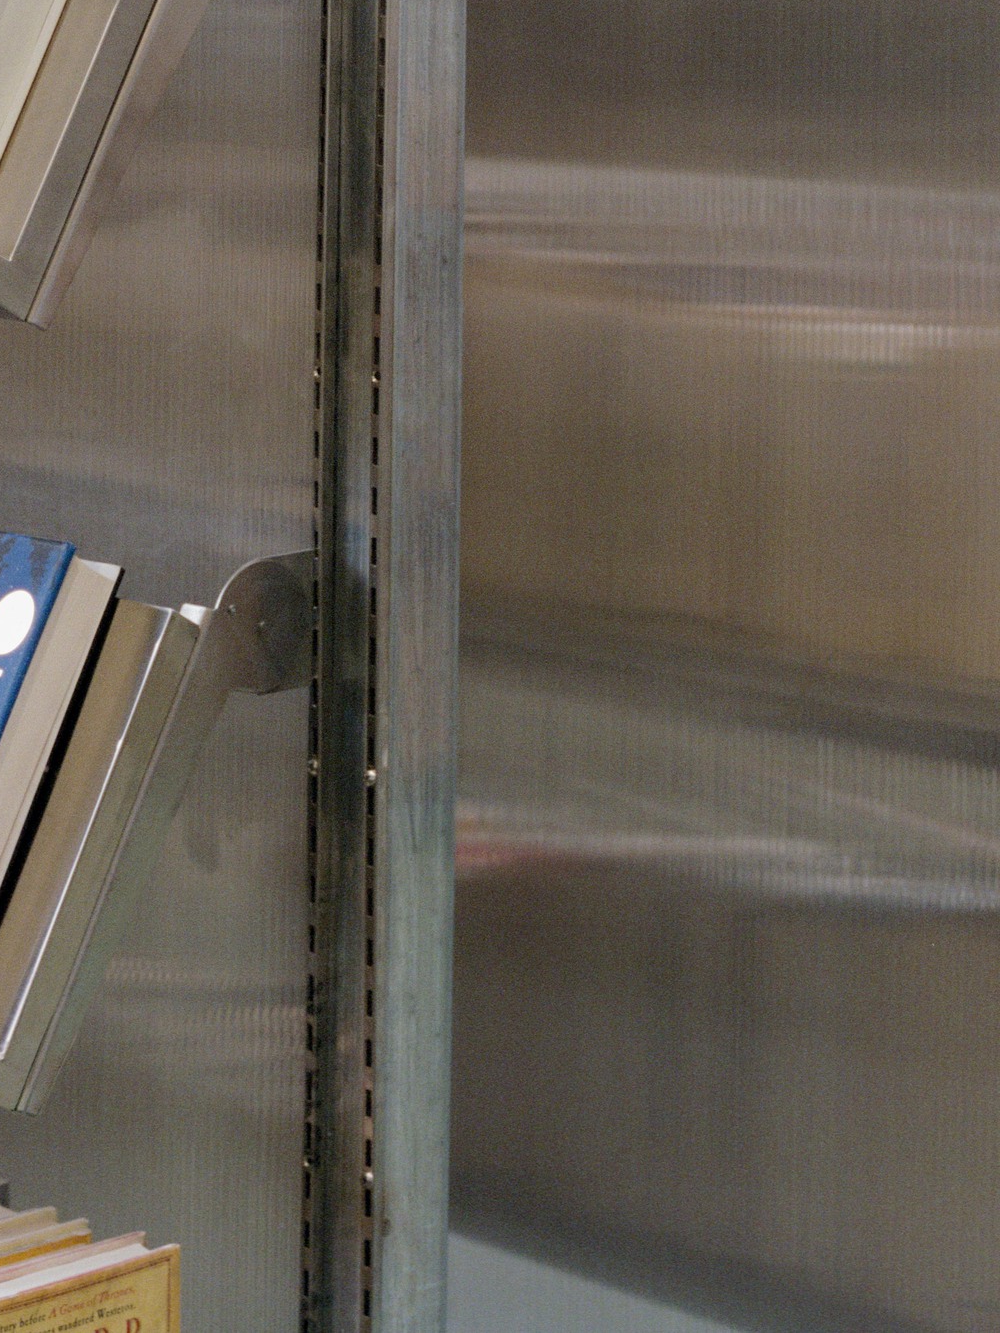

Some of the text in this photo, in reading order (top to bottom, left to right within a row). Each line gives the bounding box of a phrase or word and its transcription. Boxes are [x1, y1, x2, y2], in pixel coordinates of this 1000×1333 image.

[18, 1313, 48, 1328] before
[48, 1307, 57, 1319] A
[59, 1301, 85, 1316] Game
[86, 1294, 97, 1309] of
[57, 1314, 96, 1332] wandered
